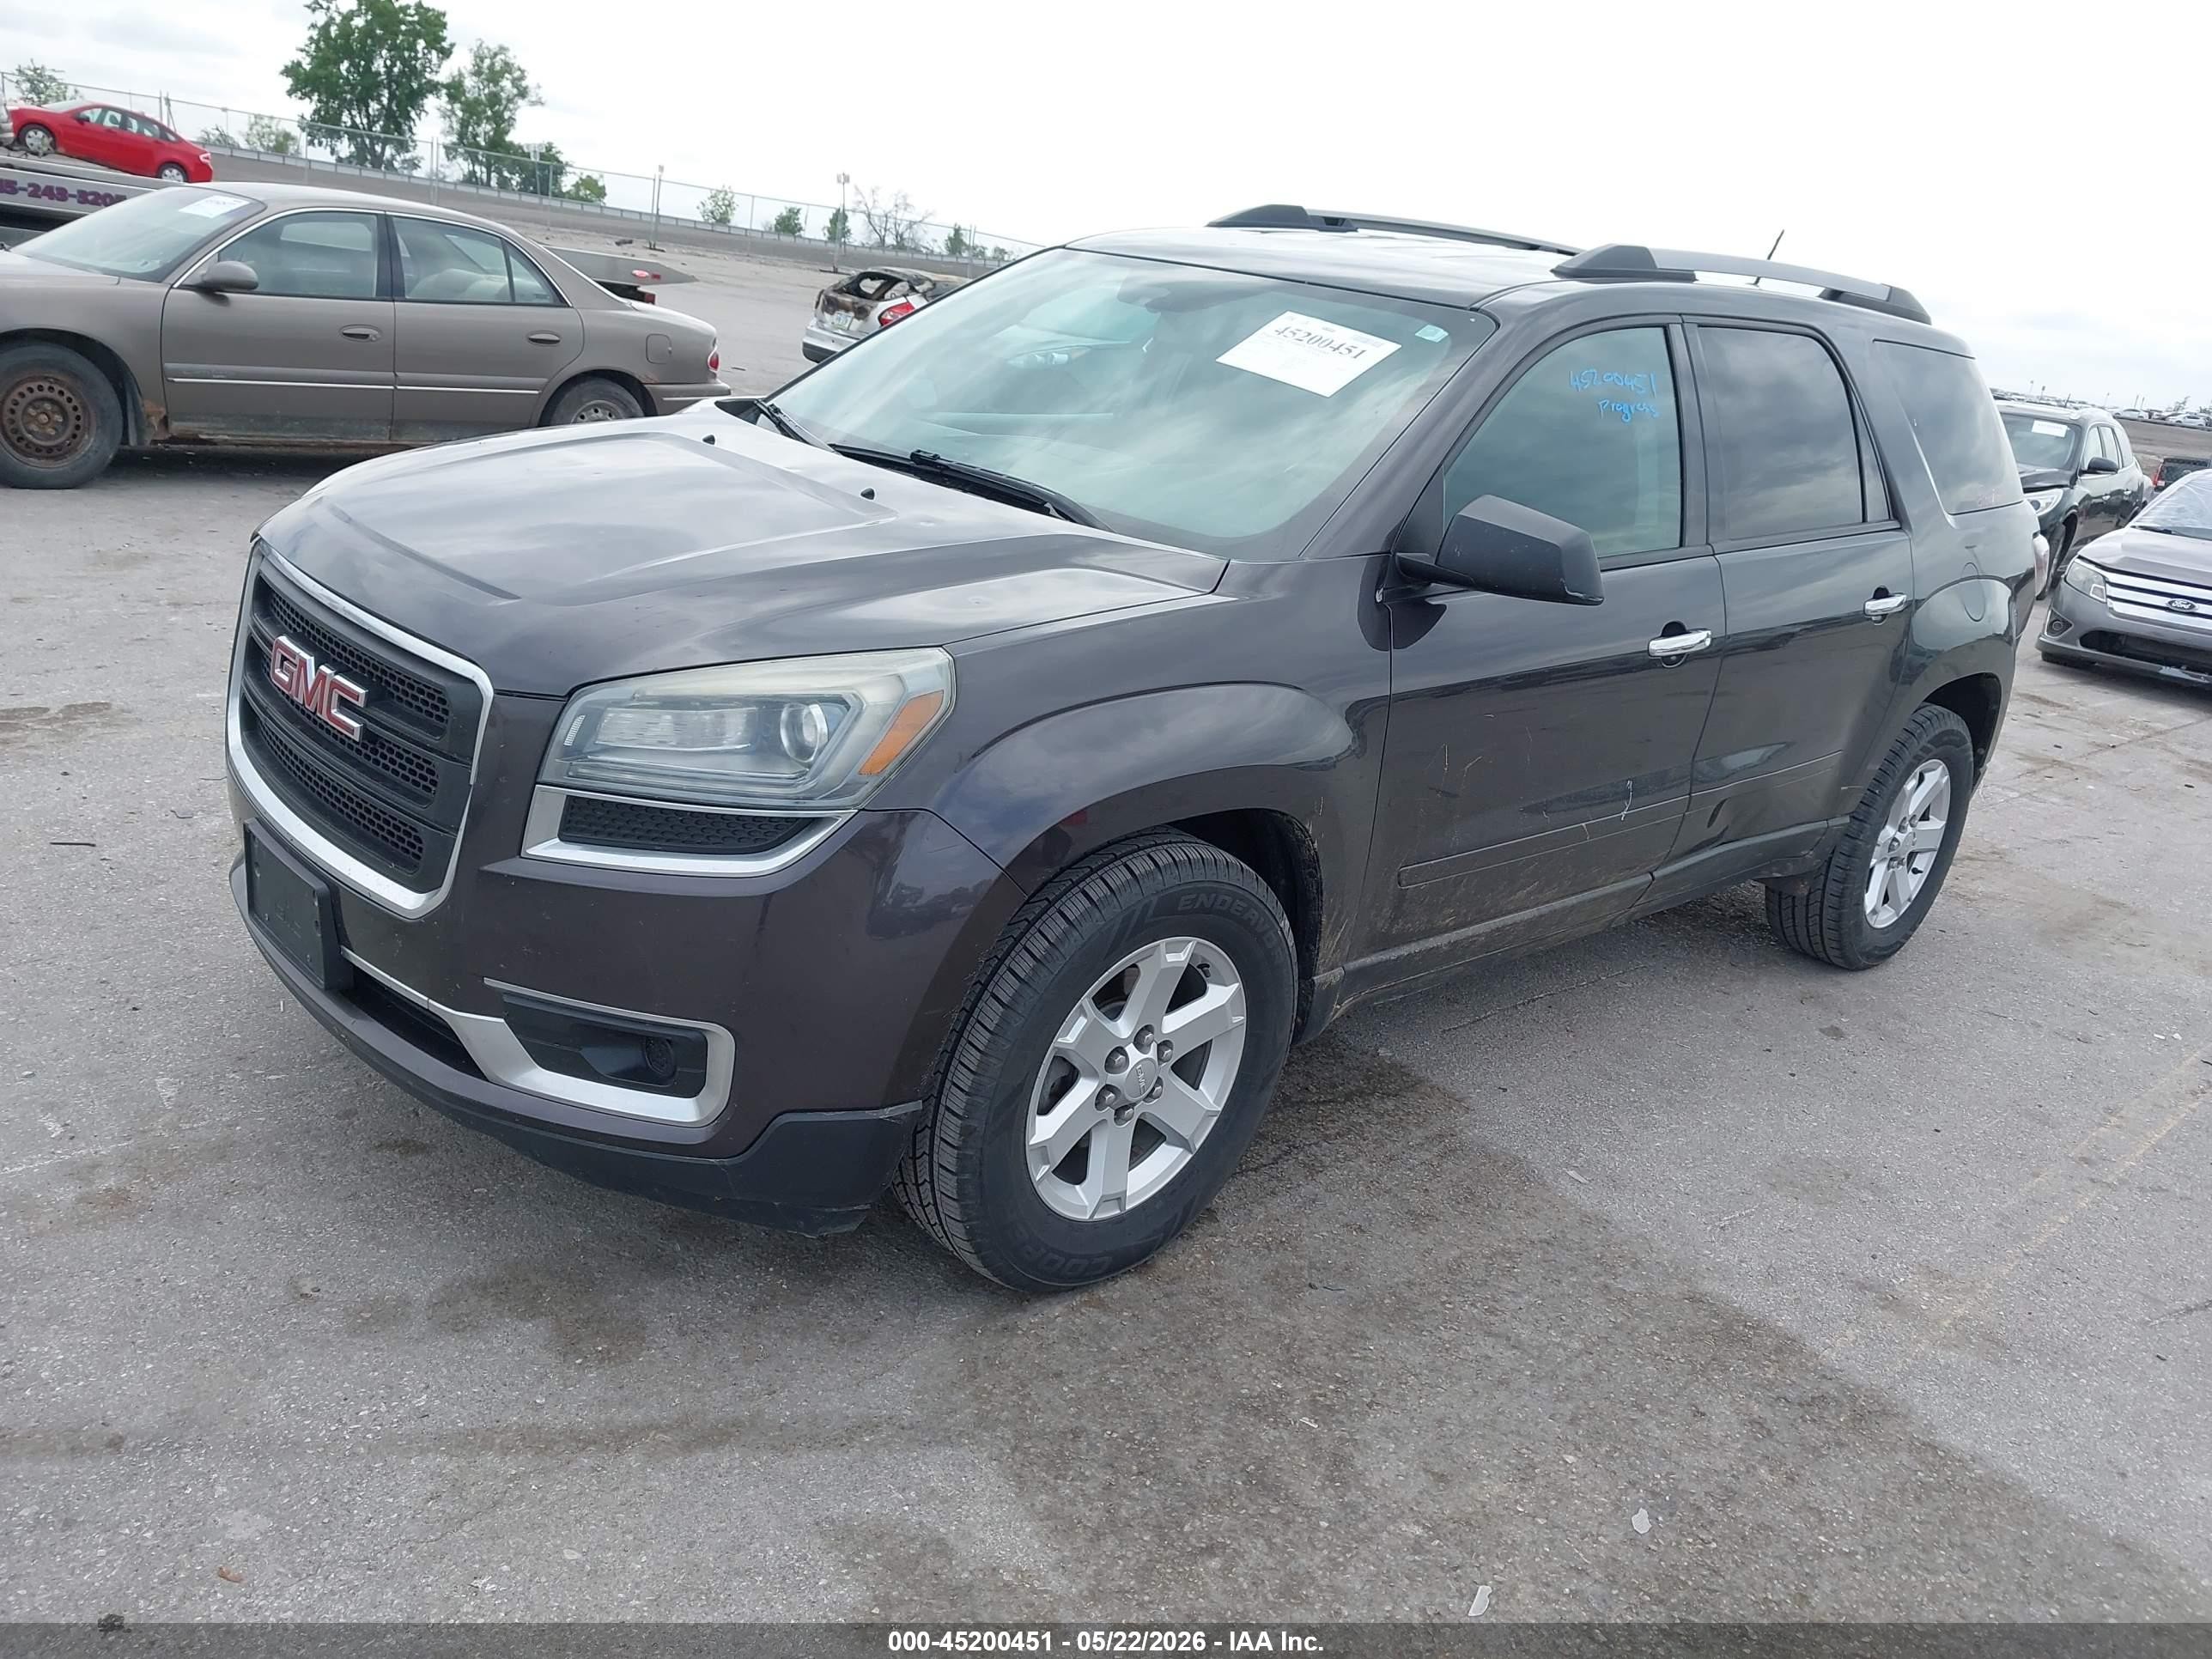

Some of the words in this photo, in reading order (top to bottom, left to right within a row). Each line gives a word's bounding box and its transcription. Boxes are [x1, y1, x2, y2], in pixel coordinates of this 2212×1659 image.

[1274, 325, 1368, 359] 45200451
[1570, 369, 1657, 398] 45200451
[270, 635, 368, 742] GMC
